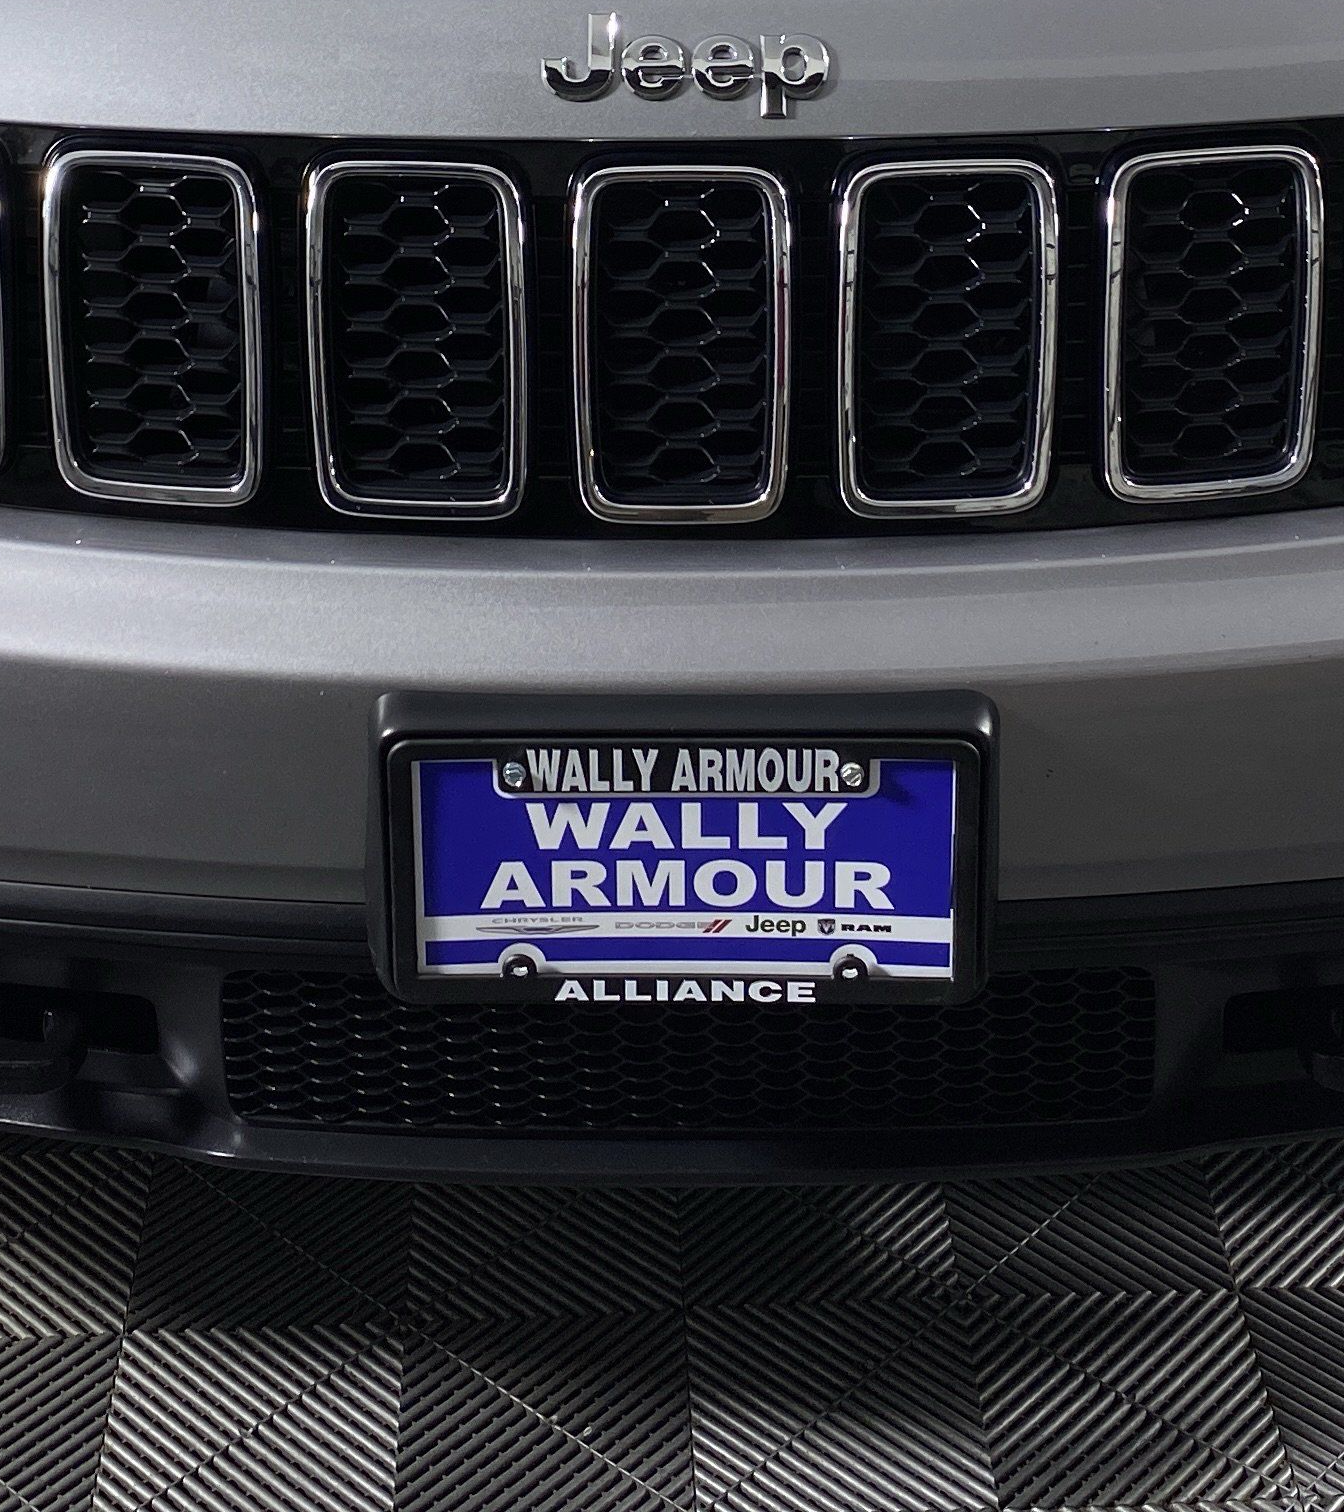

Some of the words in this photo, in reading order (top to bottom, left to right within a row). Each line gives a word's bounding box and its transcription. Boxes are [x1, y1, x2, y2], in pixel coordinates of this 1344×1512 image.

[541, 11, 830, 120] Jeep
[526, 749, 658, 793] WALLY
[672, 748, 840, 793] ARMOUR
[525, 802, 848, 850] WALLY
[480, 859, 895, 910] ARMOUR
[492, 916, 584, 924] CHRYSLER
[745, 915, 807, 936] Jeep
[840, 923, 892, 933] RAM
[554, 979, 816, 1003] ALLIANCE
